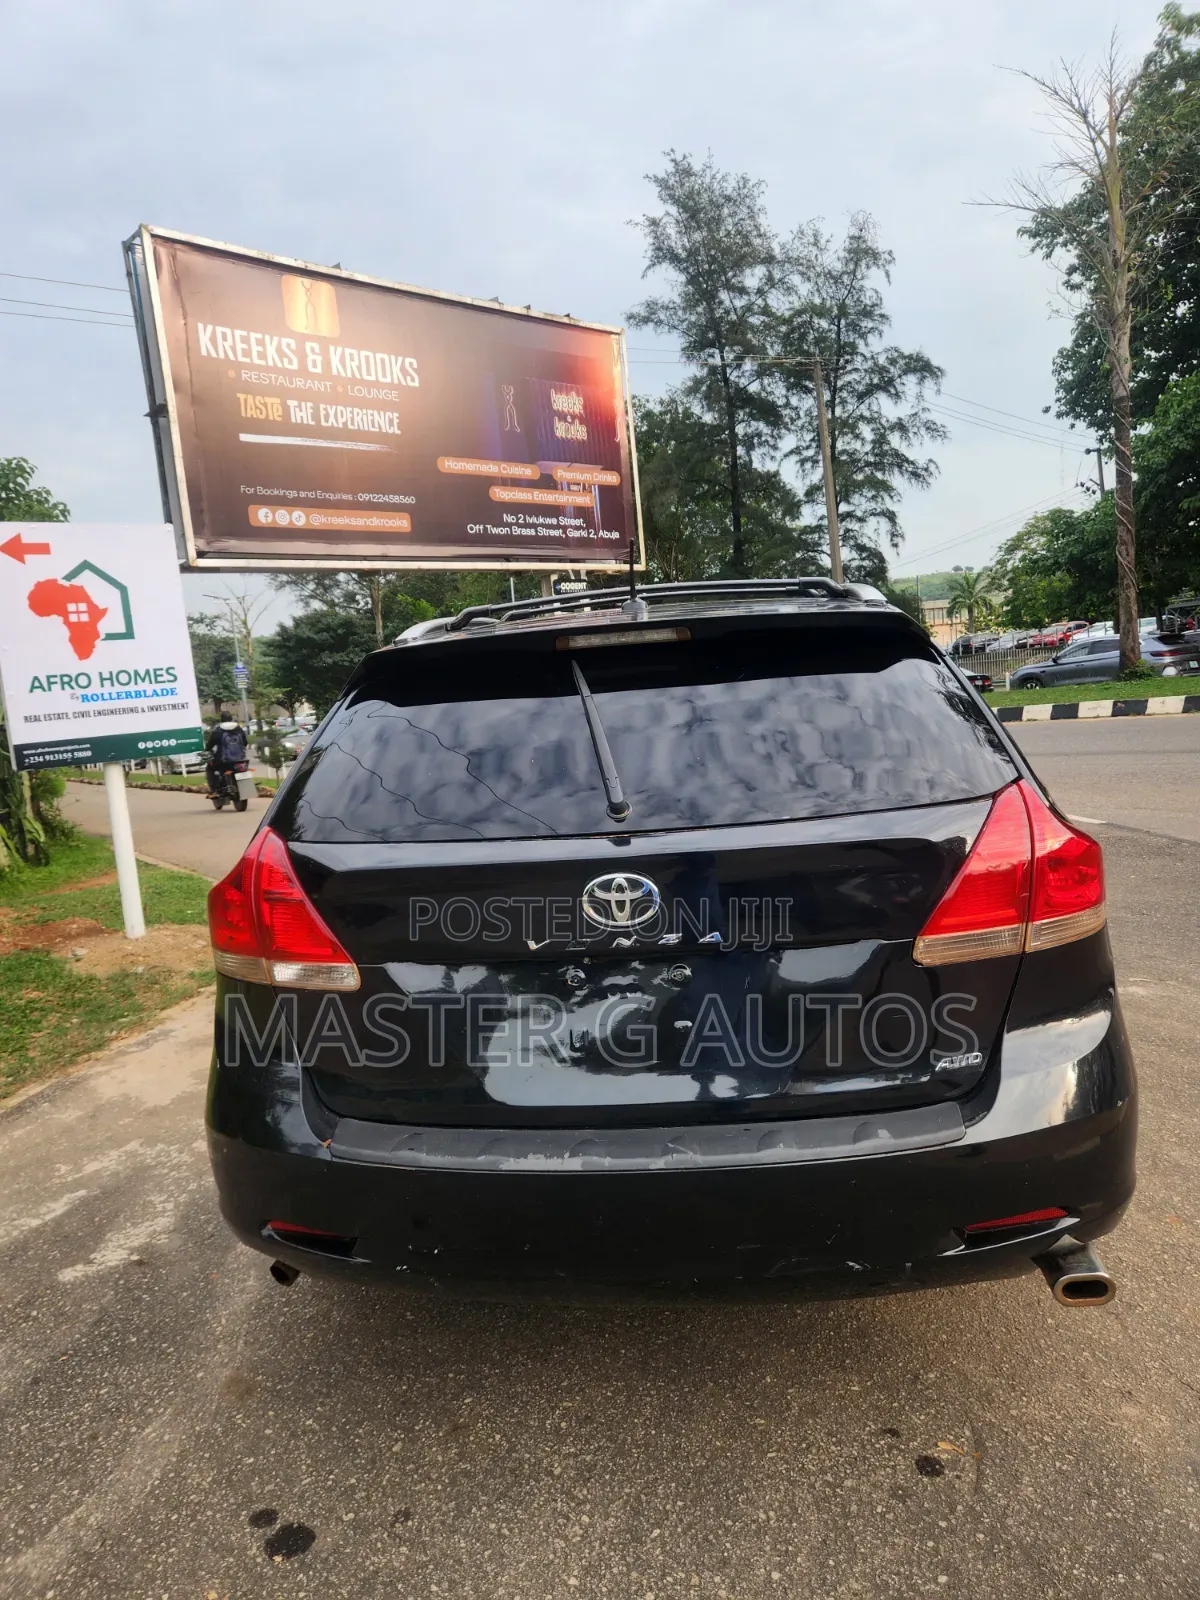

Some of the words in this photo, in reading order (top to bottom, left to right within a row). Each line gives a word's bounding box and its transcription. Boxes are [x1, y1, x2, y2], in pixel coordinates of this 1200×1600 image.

[197, 322, 298, 370] KREEKS
[305, 341, 323, 374] &
[329, 345, 420, 387] KROOKS
[241, 369, 332, 393] RESTAURANT
[347, 385, 400, 402] LOUNGE
[444, 459, 499, 473] Homemade
[500, 463, 532, 476] Cuisine
[557, 469, 592, 481] Premium
[593, 472, 617, 482] Drinks
[240, 485, 255, 494] For
[257, 486, 298, 498] Bookings
[299, 490, 316, 499] and
[317, 490, 352, 502] Enquiries
[494, 489, 533, 501] Topclass
[533, 491, 591, 505] Entertainment
[309, 513, 408, 528] @kreeksandkrooks
[503, 513, 516, 523] No
[517, 513, 525, 523] 2
[558, 516, 586, 527] Street,
[467, 523, 483, 534] Off
[485, 524, 510, 535] Twon
[512, 525, 536, 536] Brass
[537, 526, 566, 538] Street,
[566, 528, 588, 538] Garki
[588, 529, 597, 539] 2,
[598, 529, 620, 540] Abuja
[28, 672, 92, 693] AFRO
[98, 666, 178, 688] HOMES
[80, 687, 178, 703] ROLLERBLADE
[23, 714, 42, 724] REAL
[72, 710, 92, 719] CIVIL
[93, 705, 139, 717] ENGINEERING
[147, 702, 190, 713] INVESTMENT
[935, 1051, 983, 1071] AWD
